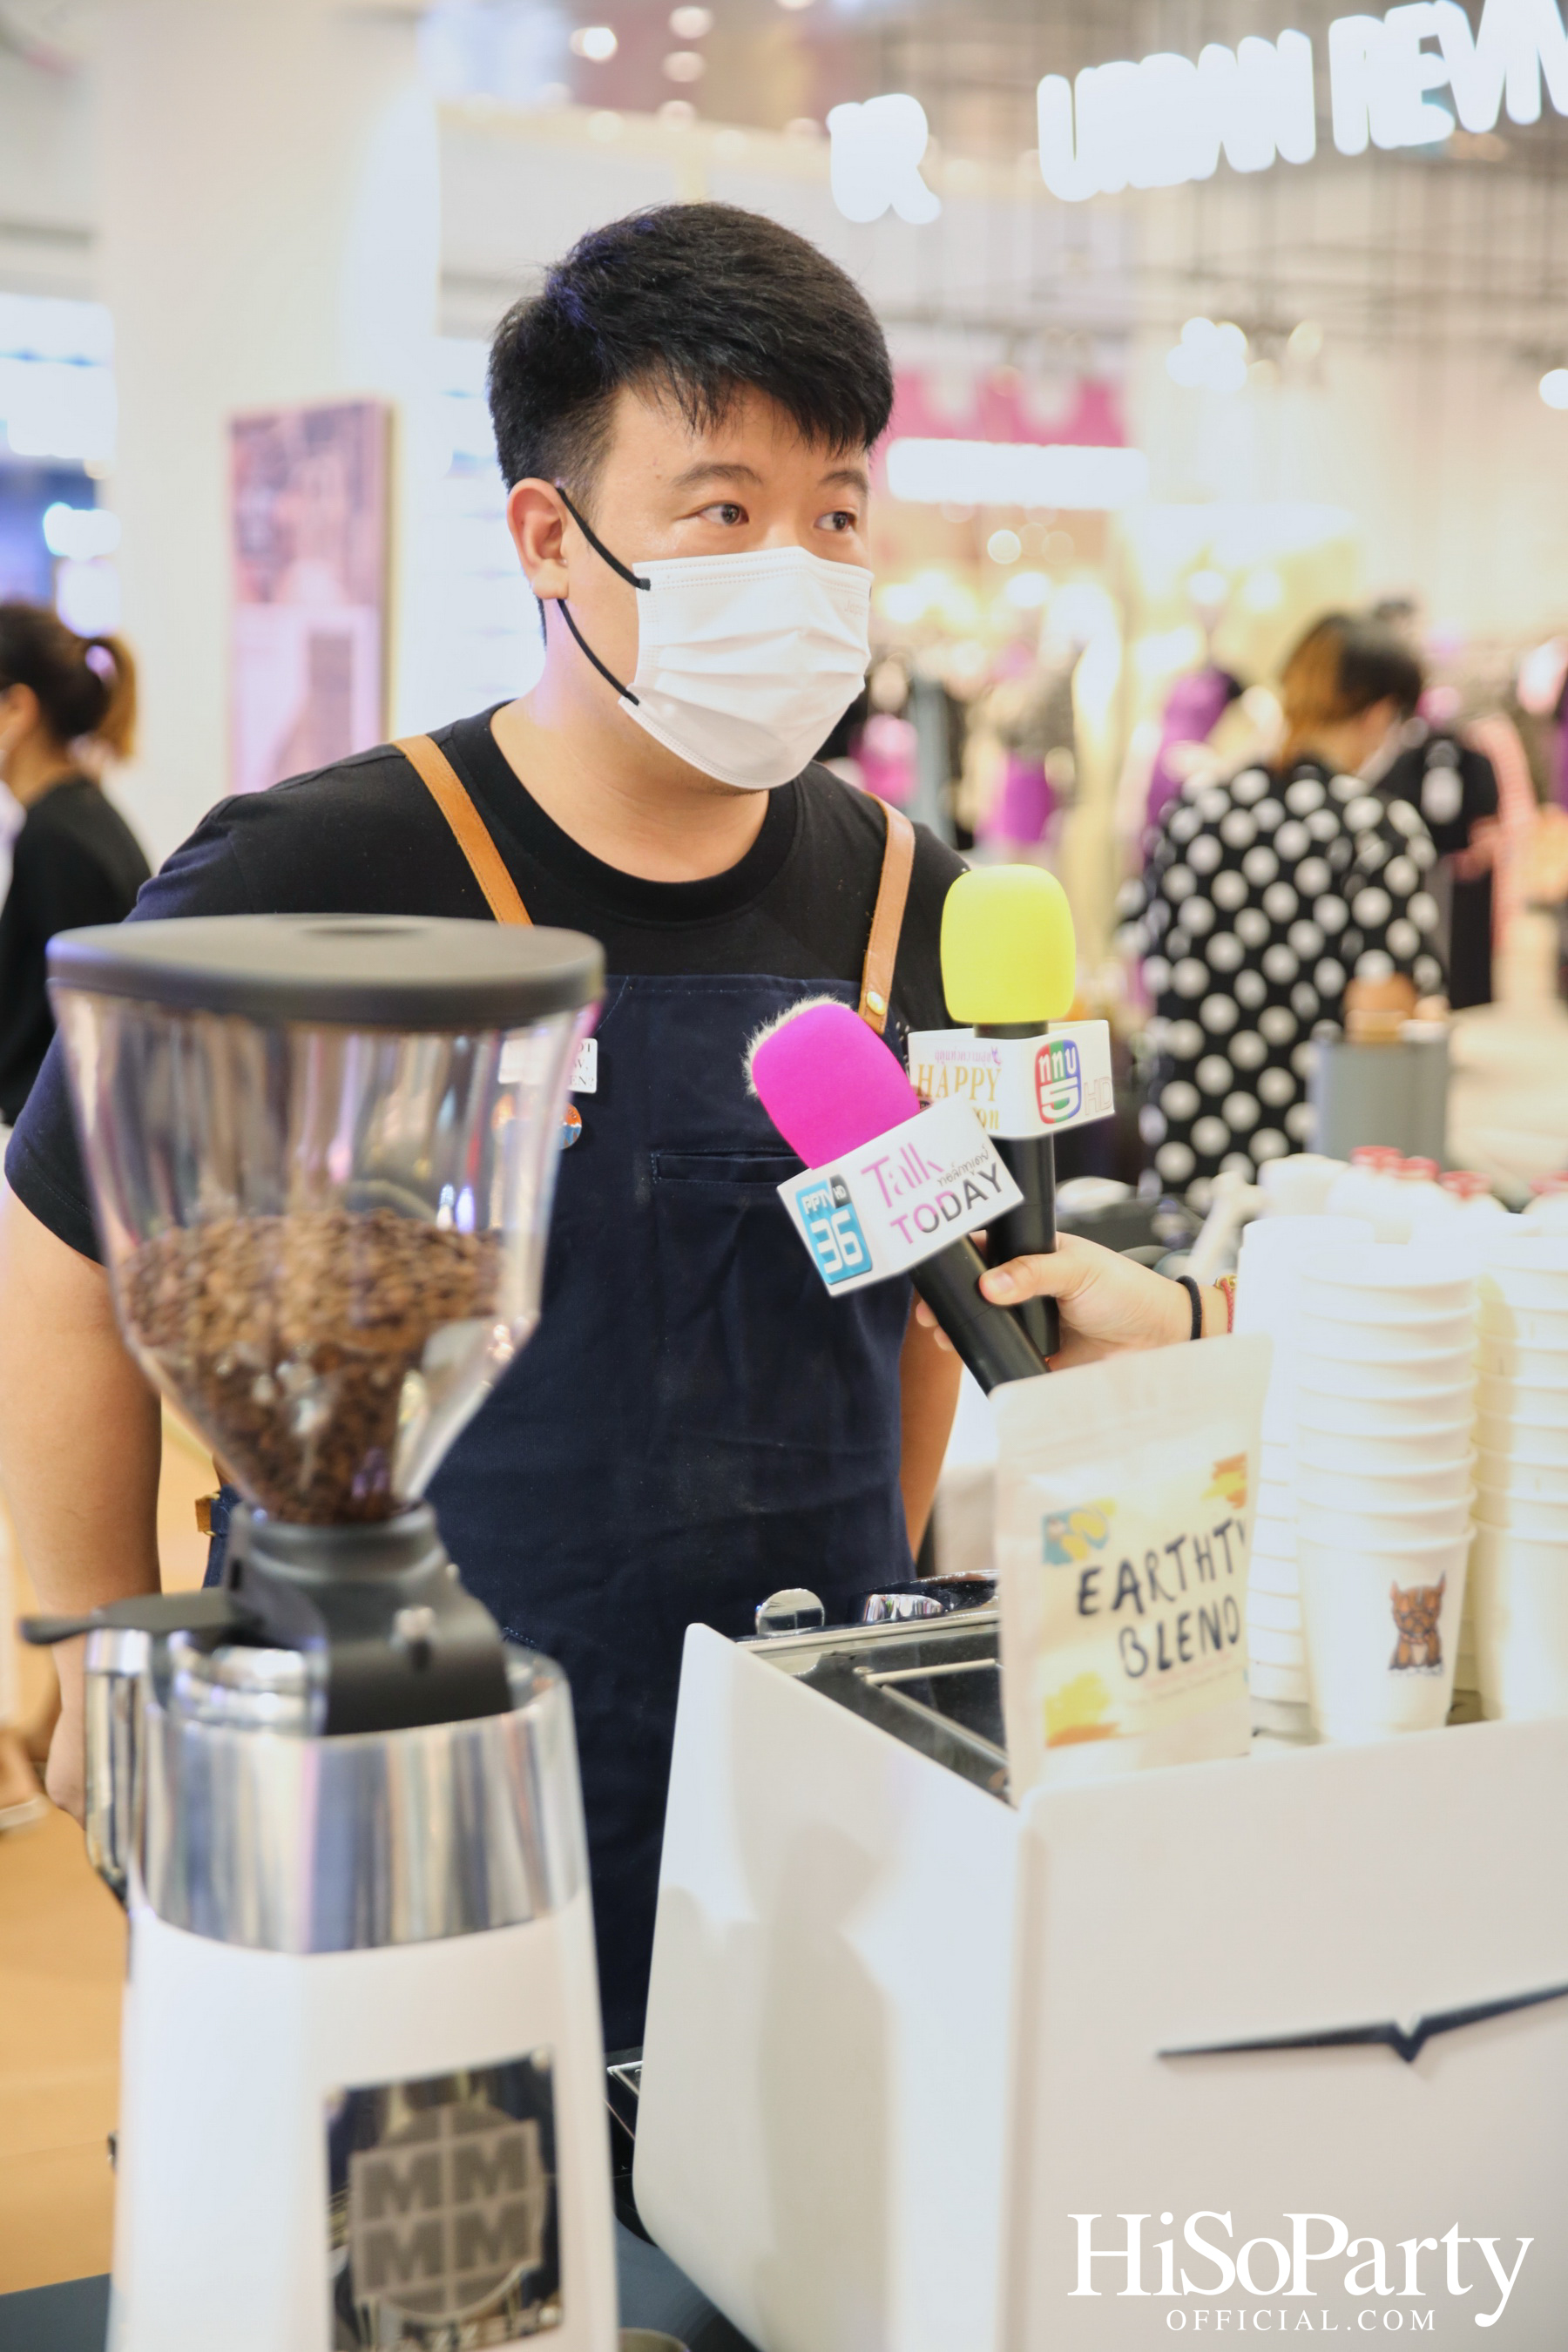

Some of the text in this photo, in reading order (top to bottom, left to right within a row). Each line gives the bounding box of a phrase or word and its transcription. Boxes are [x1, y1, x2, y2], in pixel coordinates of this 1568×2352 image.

[916, 1064, 1002, 1102] HAPPY
[1040, 1077, 1078, 1119] 5
[1084, 1076, 1113, 1116] HD
[802, 1186, 836, 1215] PPTV
[861, 1142, 944, 1208] Talk
[889, 1162, 1002, 1244] TODAY
[810, 1209, 863, 1274] 36
[1119, 1594, 1241, 1679] BLEND
